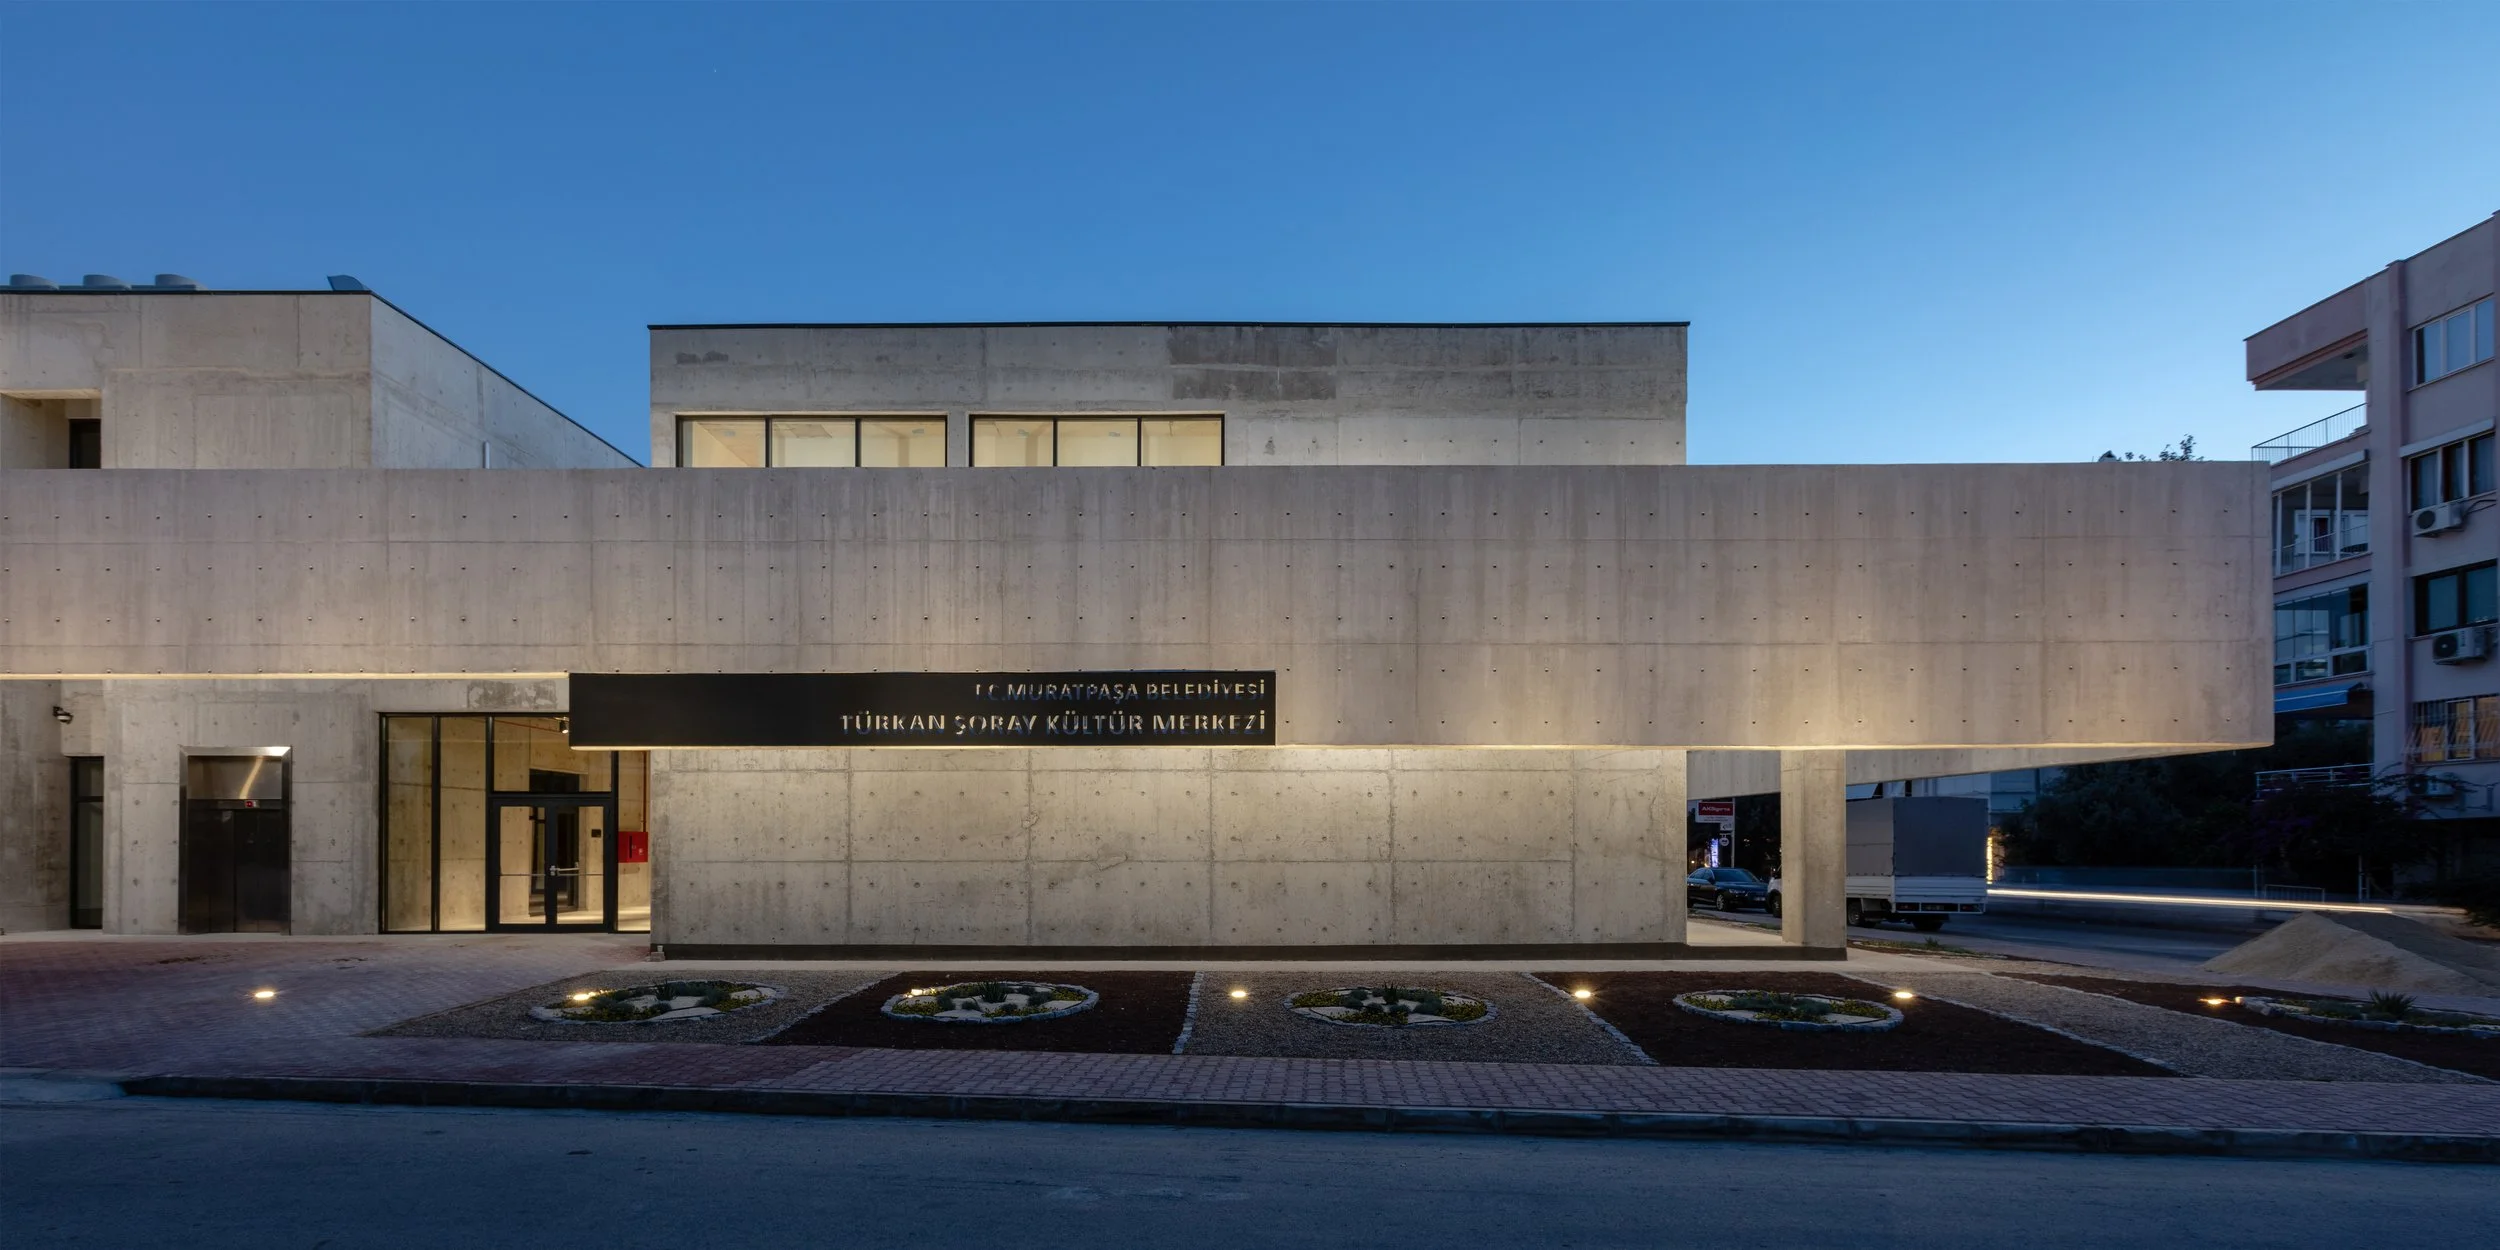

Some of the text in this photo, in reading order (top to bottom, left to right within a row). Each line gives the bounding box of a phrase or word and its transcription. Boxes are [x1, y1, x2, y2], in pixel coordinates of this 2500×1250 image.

[1146, 679, 1265, 700] BELEDİYESİ
[839, 709, 1265, 740] TÜRKAN ŞORAY KÜLTÜR MERKEZİ
